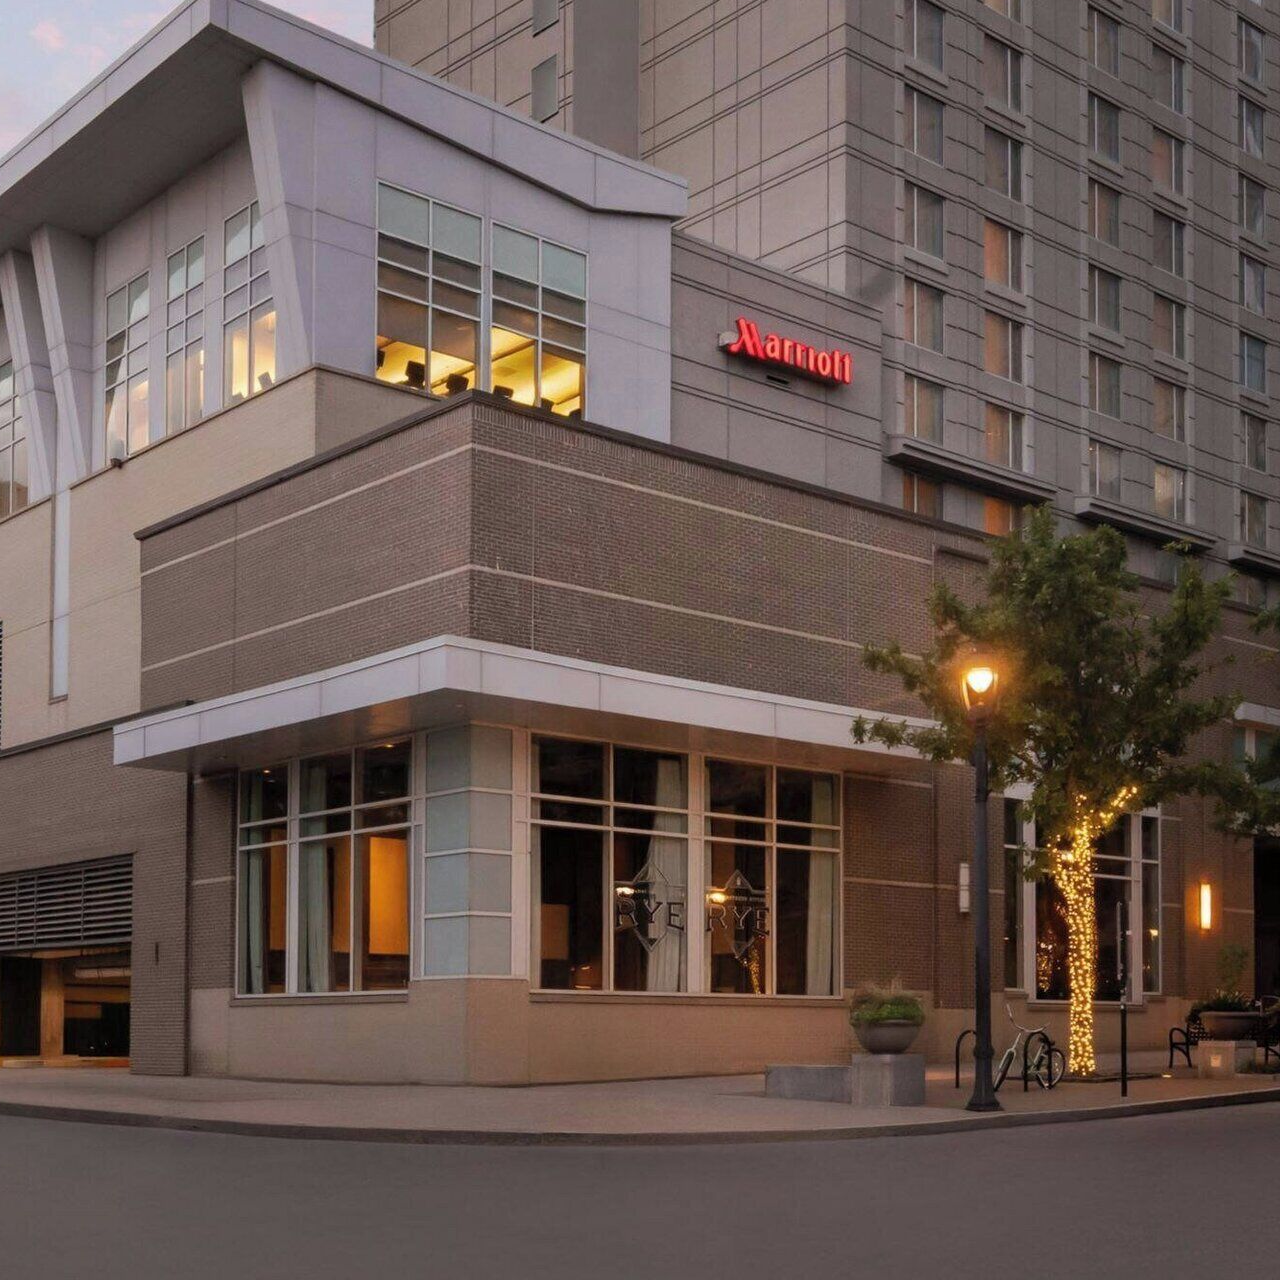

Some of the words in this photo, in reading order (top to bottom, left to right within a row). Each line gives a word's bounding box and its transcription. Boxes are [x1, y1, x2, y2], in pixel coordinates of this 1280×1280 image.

[728, 317, 853, 384] Marriott
[615, 897, 686, 932] RYE
[706, 902, 770, 937] RYE
